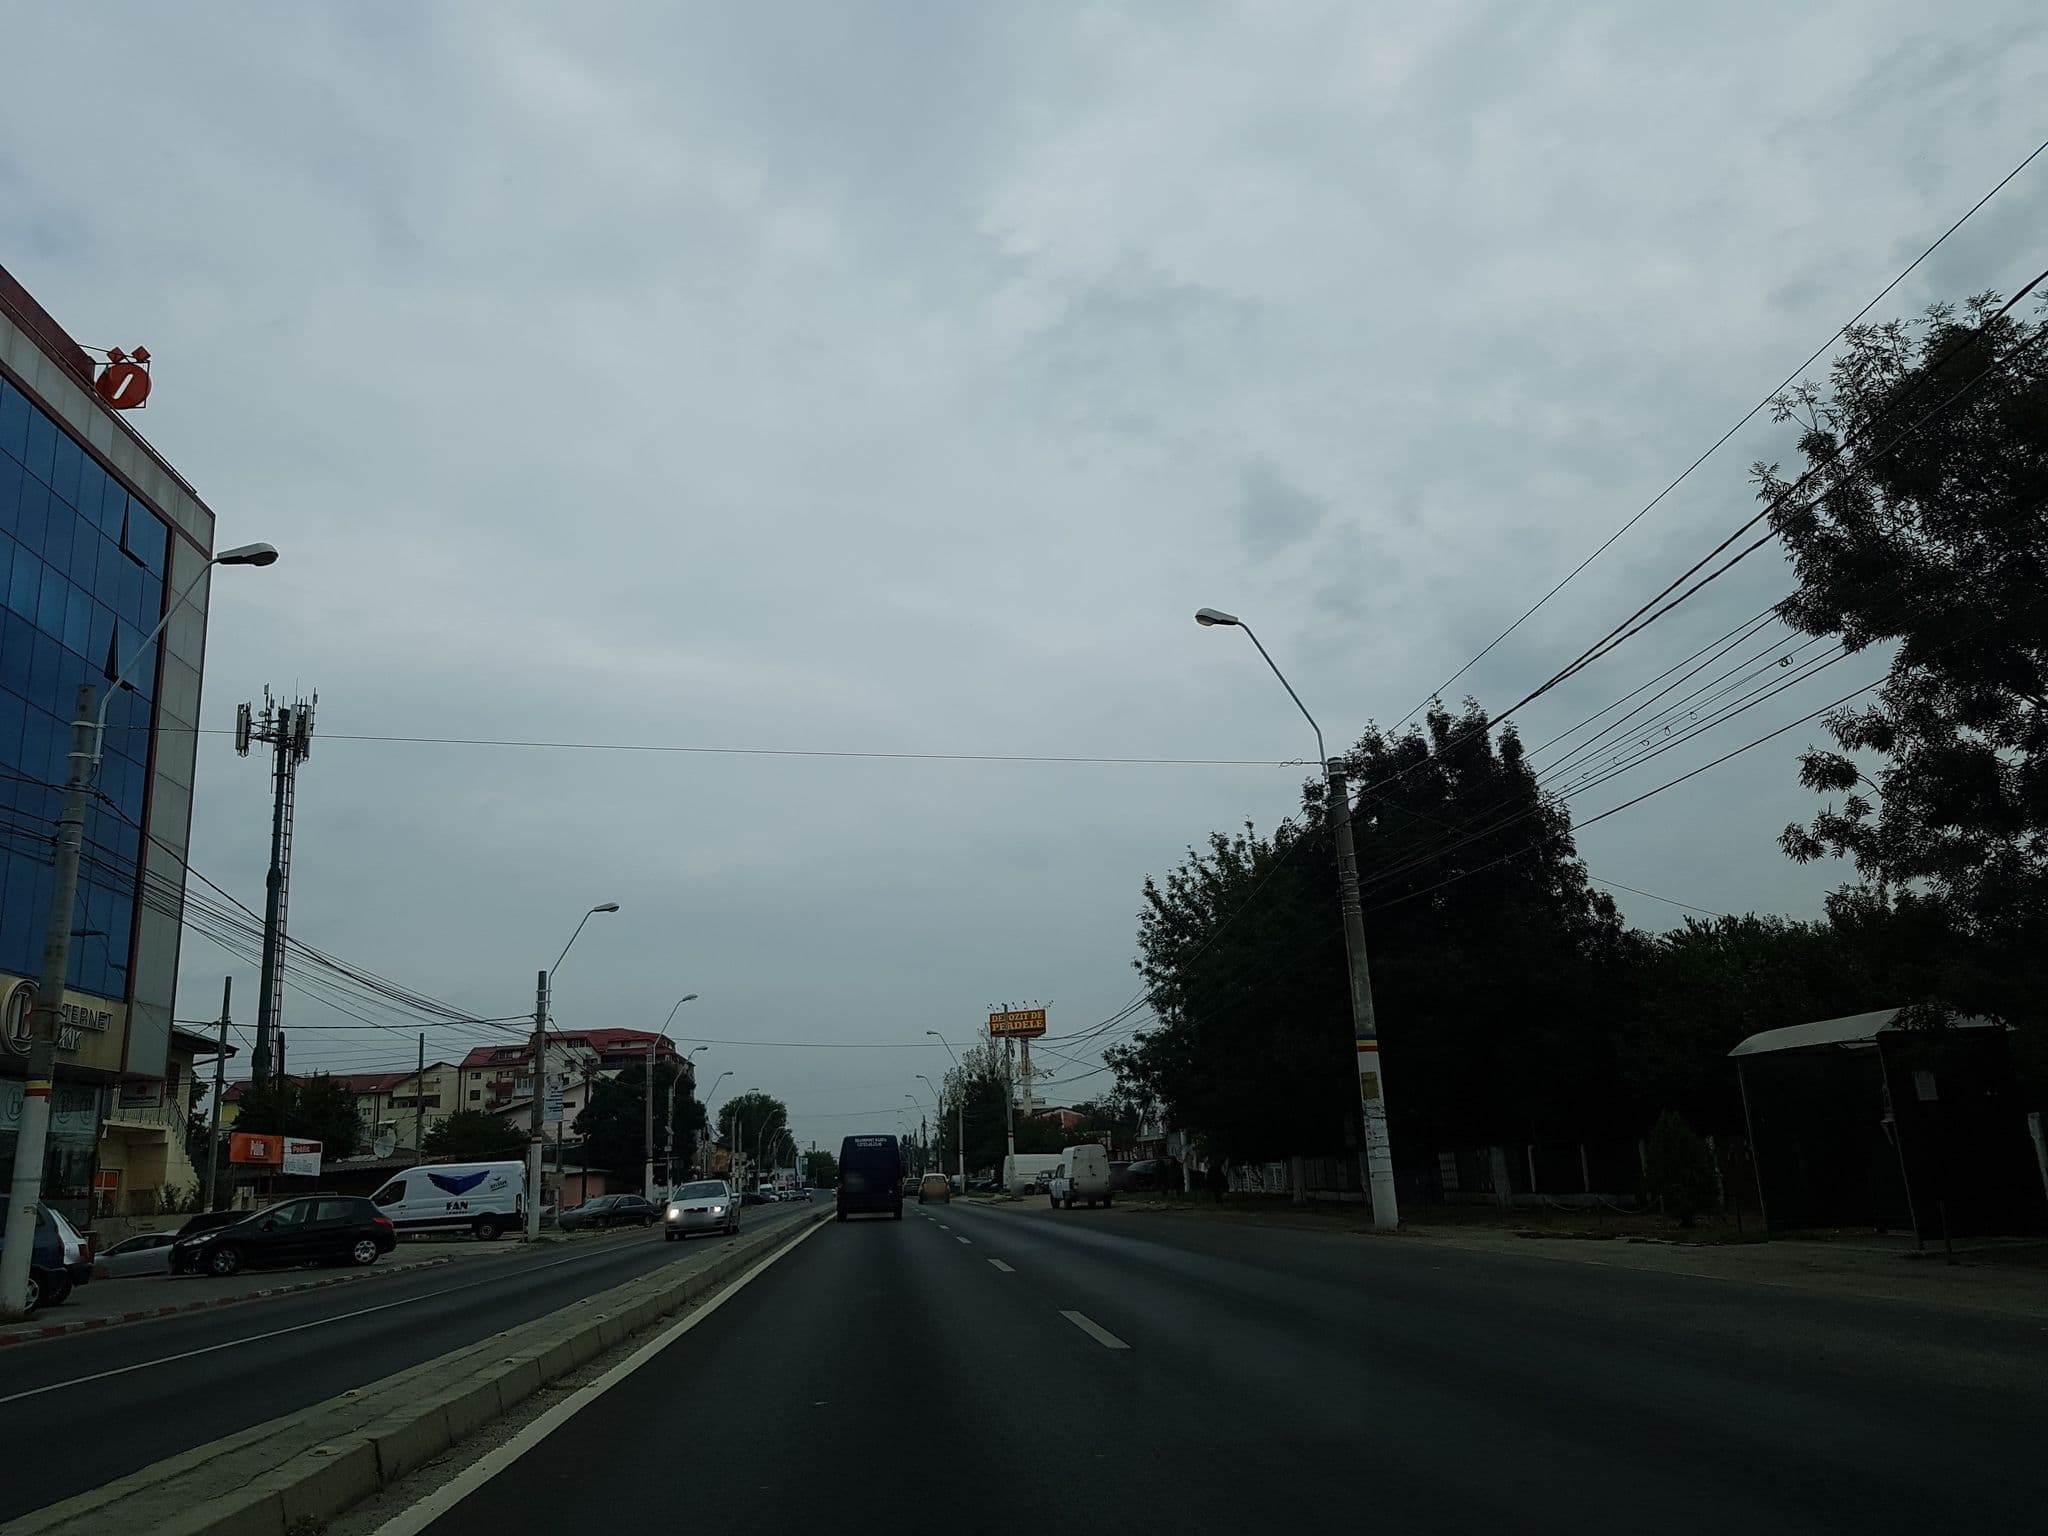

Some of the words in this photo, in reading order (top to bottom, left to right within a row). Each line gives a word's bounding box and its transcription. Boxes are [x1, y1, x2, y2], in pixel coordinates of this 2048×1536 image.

[62, 1003, 114, 1033] TERNET
[992, 1012, 1029, 1022] DEOZIT
[1031, 1011, 1043, 1019] DE
[446, 1201, 468, 1211] FAN
